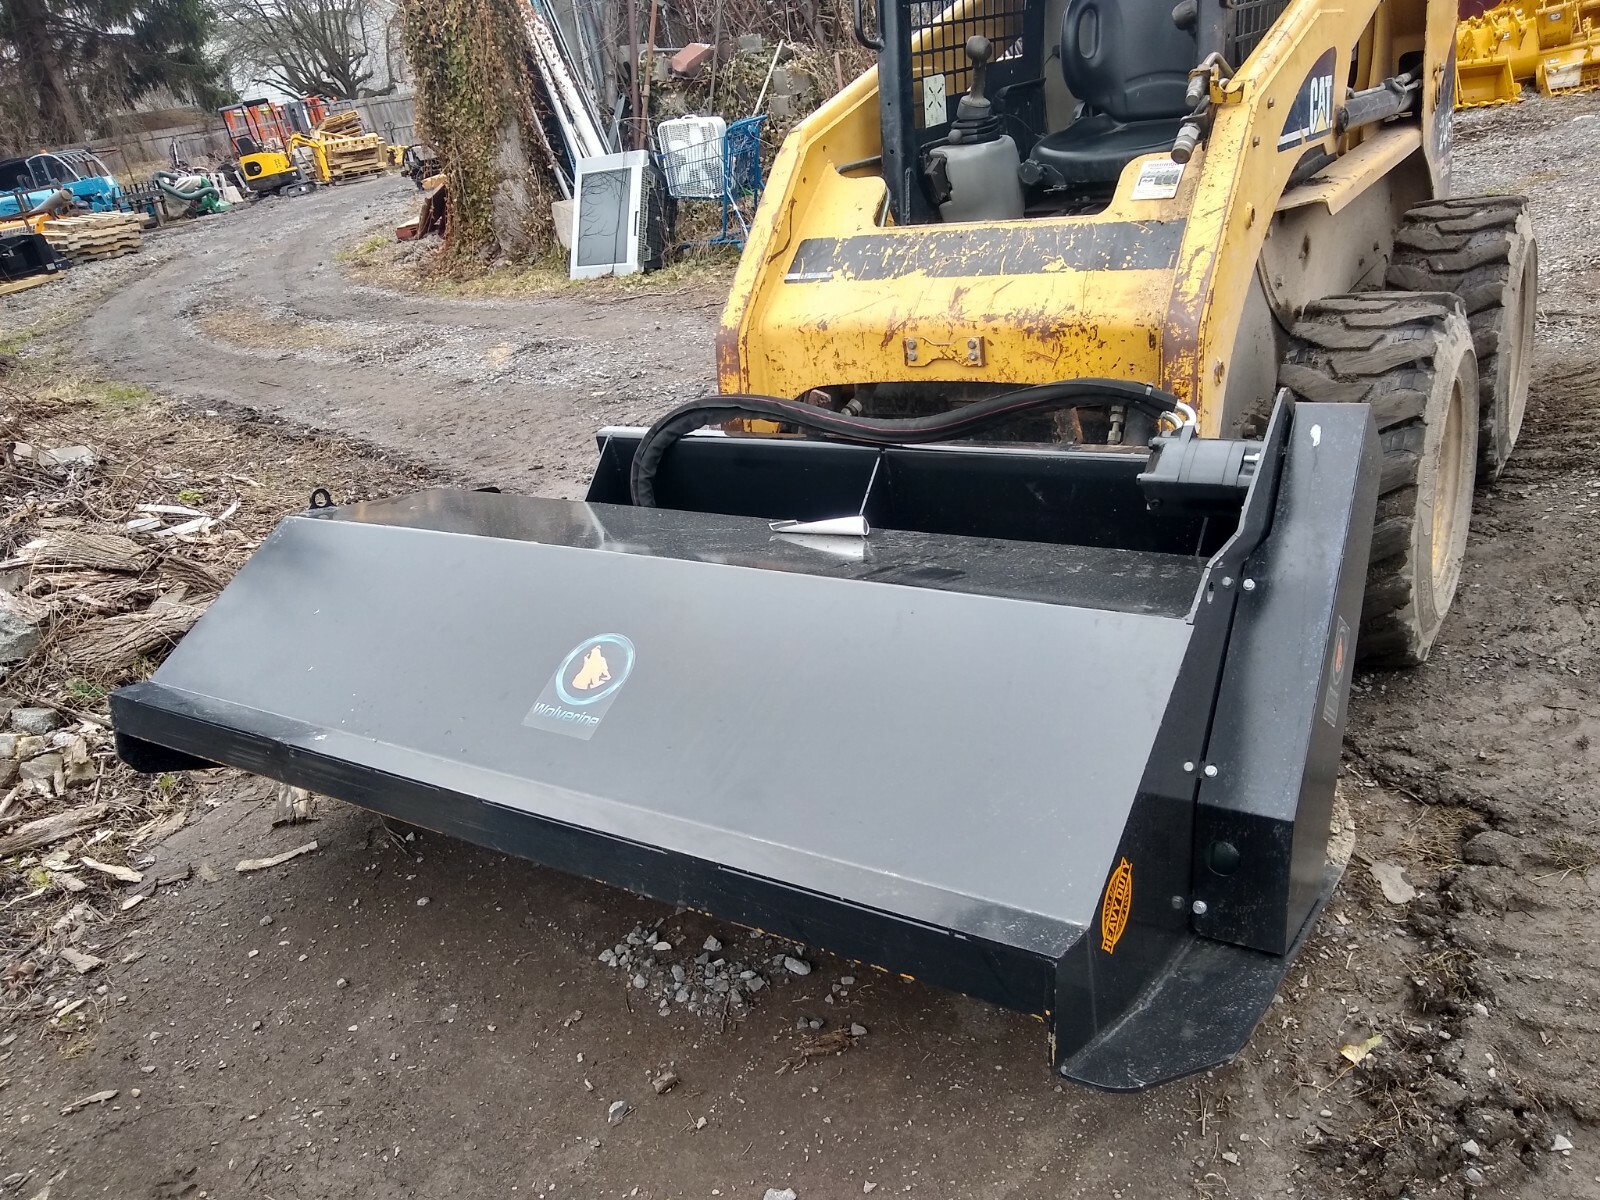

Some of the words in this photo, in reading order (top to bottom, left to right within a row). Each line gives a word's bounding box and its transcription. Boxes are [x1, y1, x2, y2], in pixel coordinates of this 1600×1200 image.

[1310, 75, 1332, 134] CAT
[532, 702, 600, 726] Wolverine
[1104, 899, 1121, 953] HEAVY
[1117, 861, 1131, 900] DUTY
